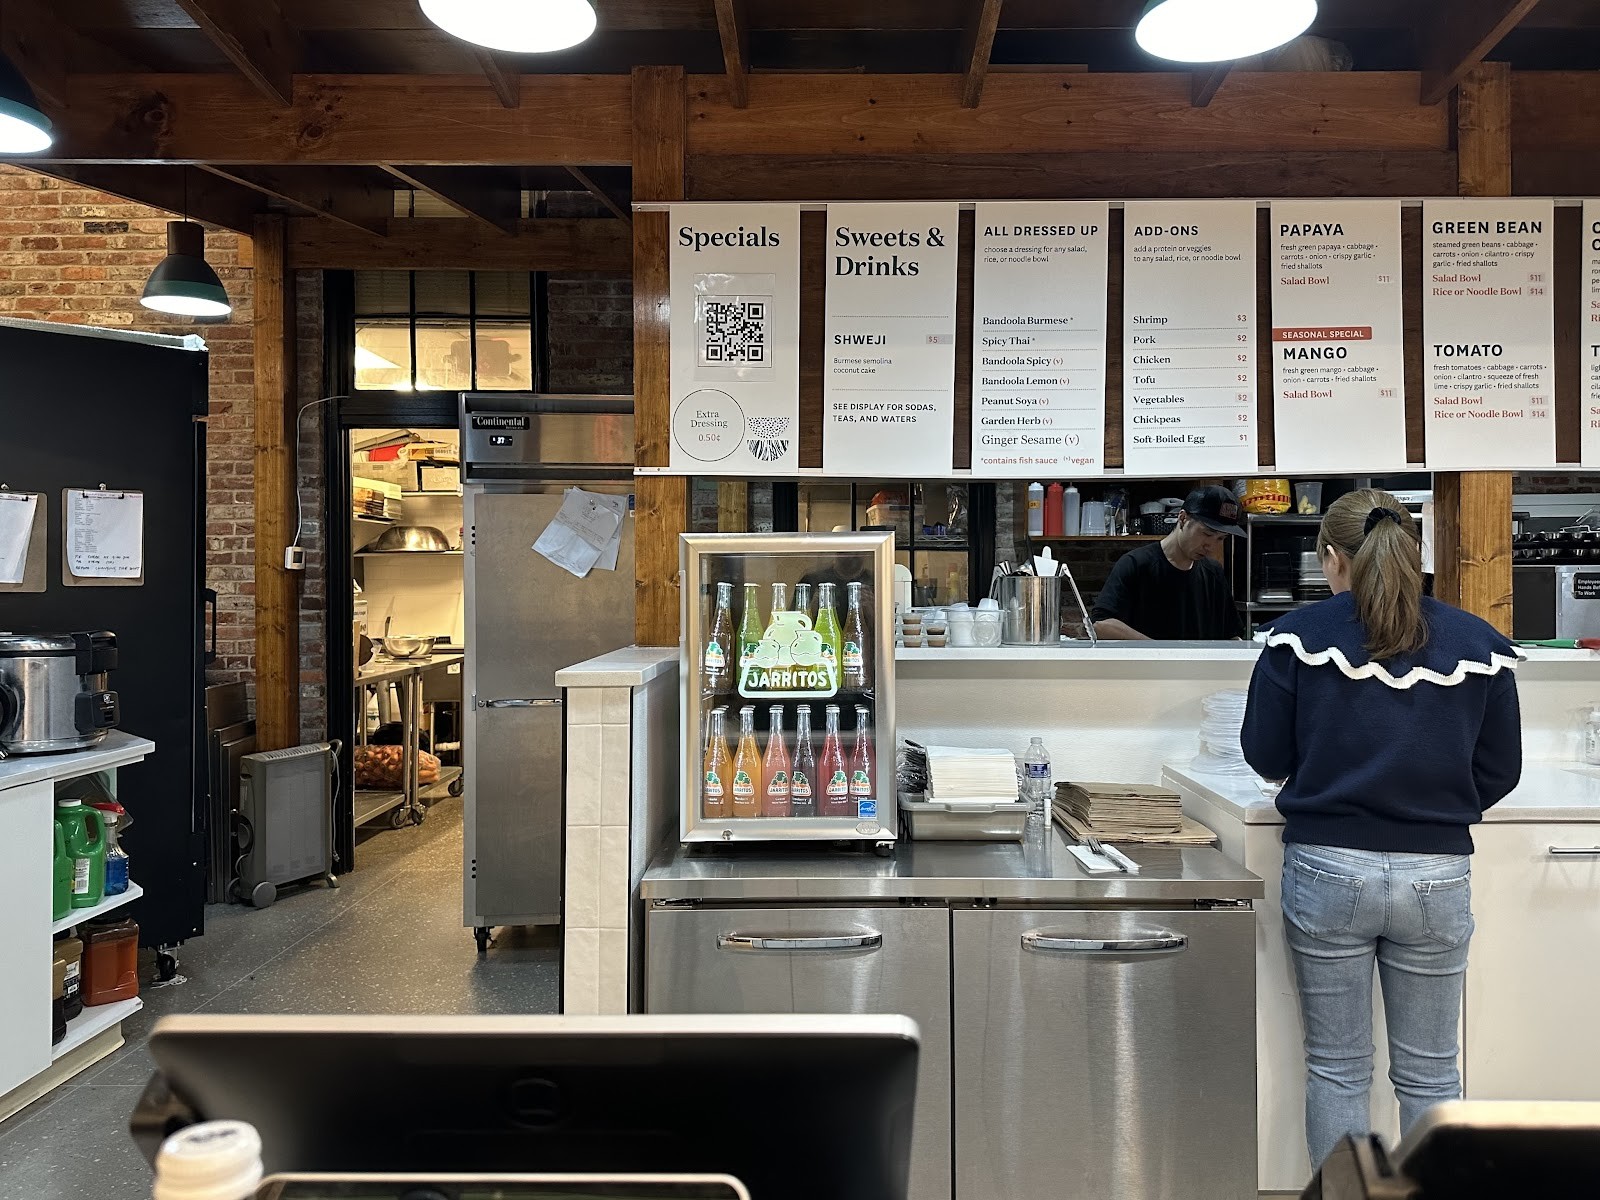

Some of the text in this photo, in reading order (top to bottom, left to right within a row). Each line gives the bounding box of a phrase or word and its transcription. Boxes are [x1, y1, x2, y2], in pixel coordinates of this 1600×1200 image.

[984, 226, 1098, 236] ALL DRESSED UP
[1134, 226, 1198, 236] ADD-ONS
[1280, 224, 1344, 236] PAPAYA
[1433, 222, 1542, 233] GREEN BEAN
[679, 227, 780, 252] Specials
[836, 227, 945, 247] Sweets &
[1015, 246, 1042, 254] dressing
[835, 256, 919, 276] Drinks
[1280, 277, 1305, 285] Salad
[1308, 276, 1329, 284] Bowl
[1433, 274, 1541, 282] Salad Bowl $11
[1433, 288, 1452, 296] Rice
[1466, 288, 1498, 296] Noodle
[1133, 316, 1168, 325] Shrimp
[834, 335, 886, 344] SHWEJI
[982, 336, 1029, 346] Spicy Thai
[1133, 336, 1156, 344] Pork
[1284, 347, 1347, 360] MANGO
[1434, 344, 1502, 357] TOMATO
[982, 357, 1024, 365] Bandoola
[1026, 357, 1051, 366] Spicy
[1133, 356, 1170, 364] Chicken
[982, 377, 1024, 385] Bandoola
[1133, 376, 1155, 384] Tofu
[1311, 390, 1332, 398] Bowl
[982, 397, 1013, 405] Peanut
[1016, 397, 1037, 406] Soya
[1133, 396, 1184, 405] Vegetables
[1434, 397, 1458, 405] Salad
[906, 404, 936, 412] SODAS,
[696, 410, 719, 418] Extra
[1502, 410, 1523, 418] Bowl
[477, 417, 524, 426] Continental
[691, 419, 728, 428] Dressing
[833, 415, 856, 423] TEAS,
[1133, 416, 1180, 425] Chickpeas
[698, 434, 720, 442] 0.50¢
[982, 434, 1080, 447] Ginger Sesame (v)
[1133, 435, 1184, 443] Soft-Boiled
[1188, 435, 1205, 444] Egg
[748, 672, 827, 688] JARRITOS
